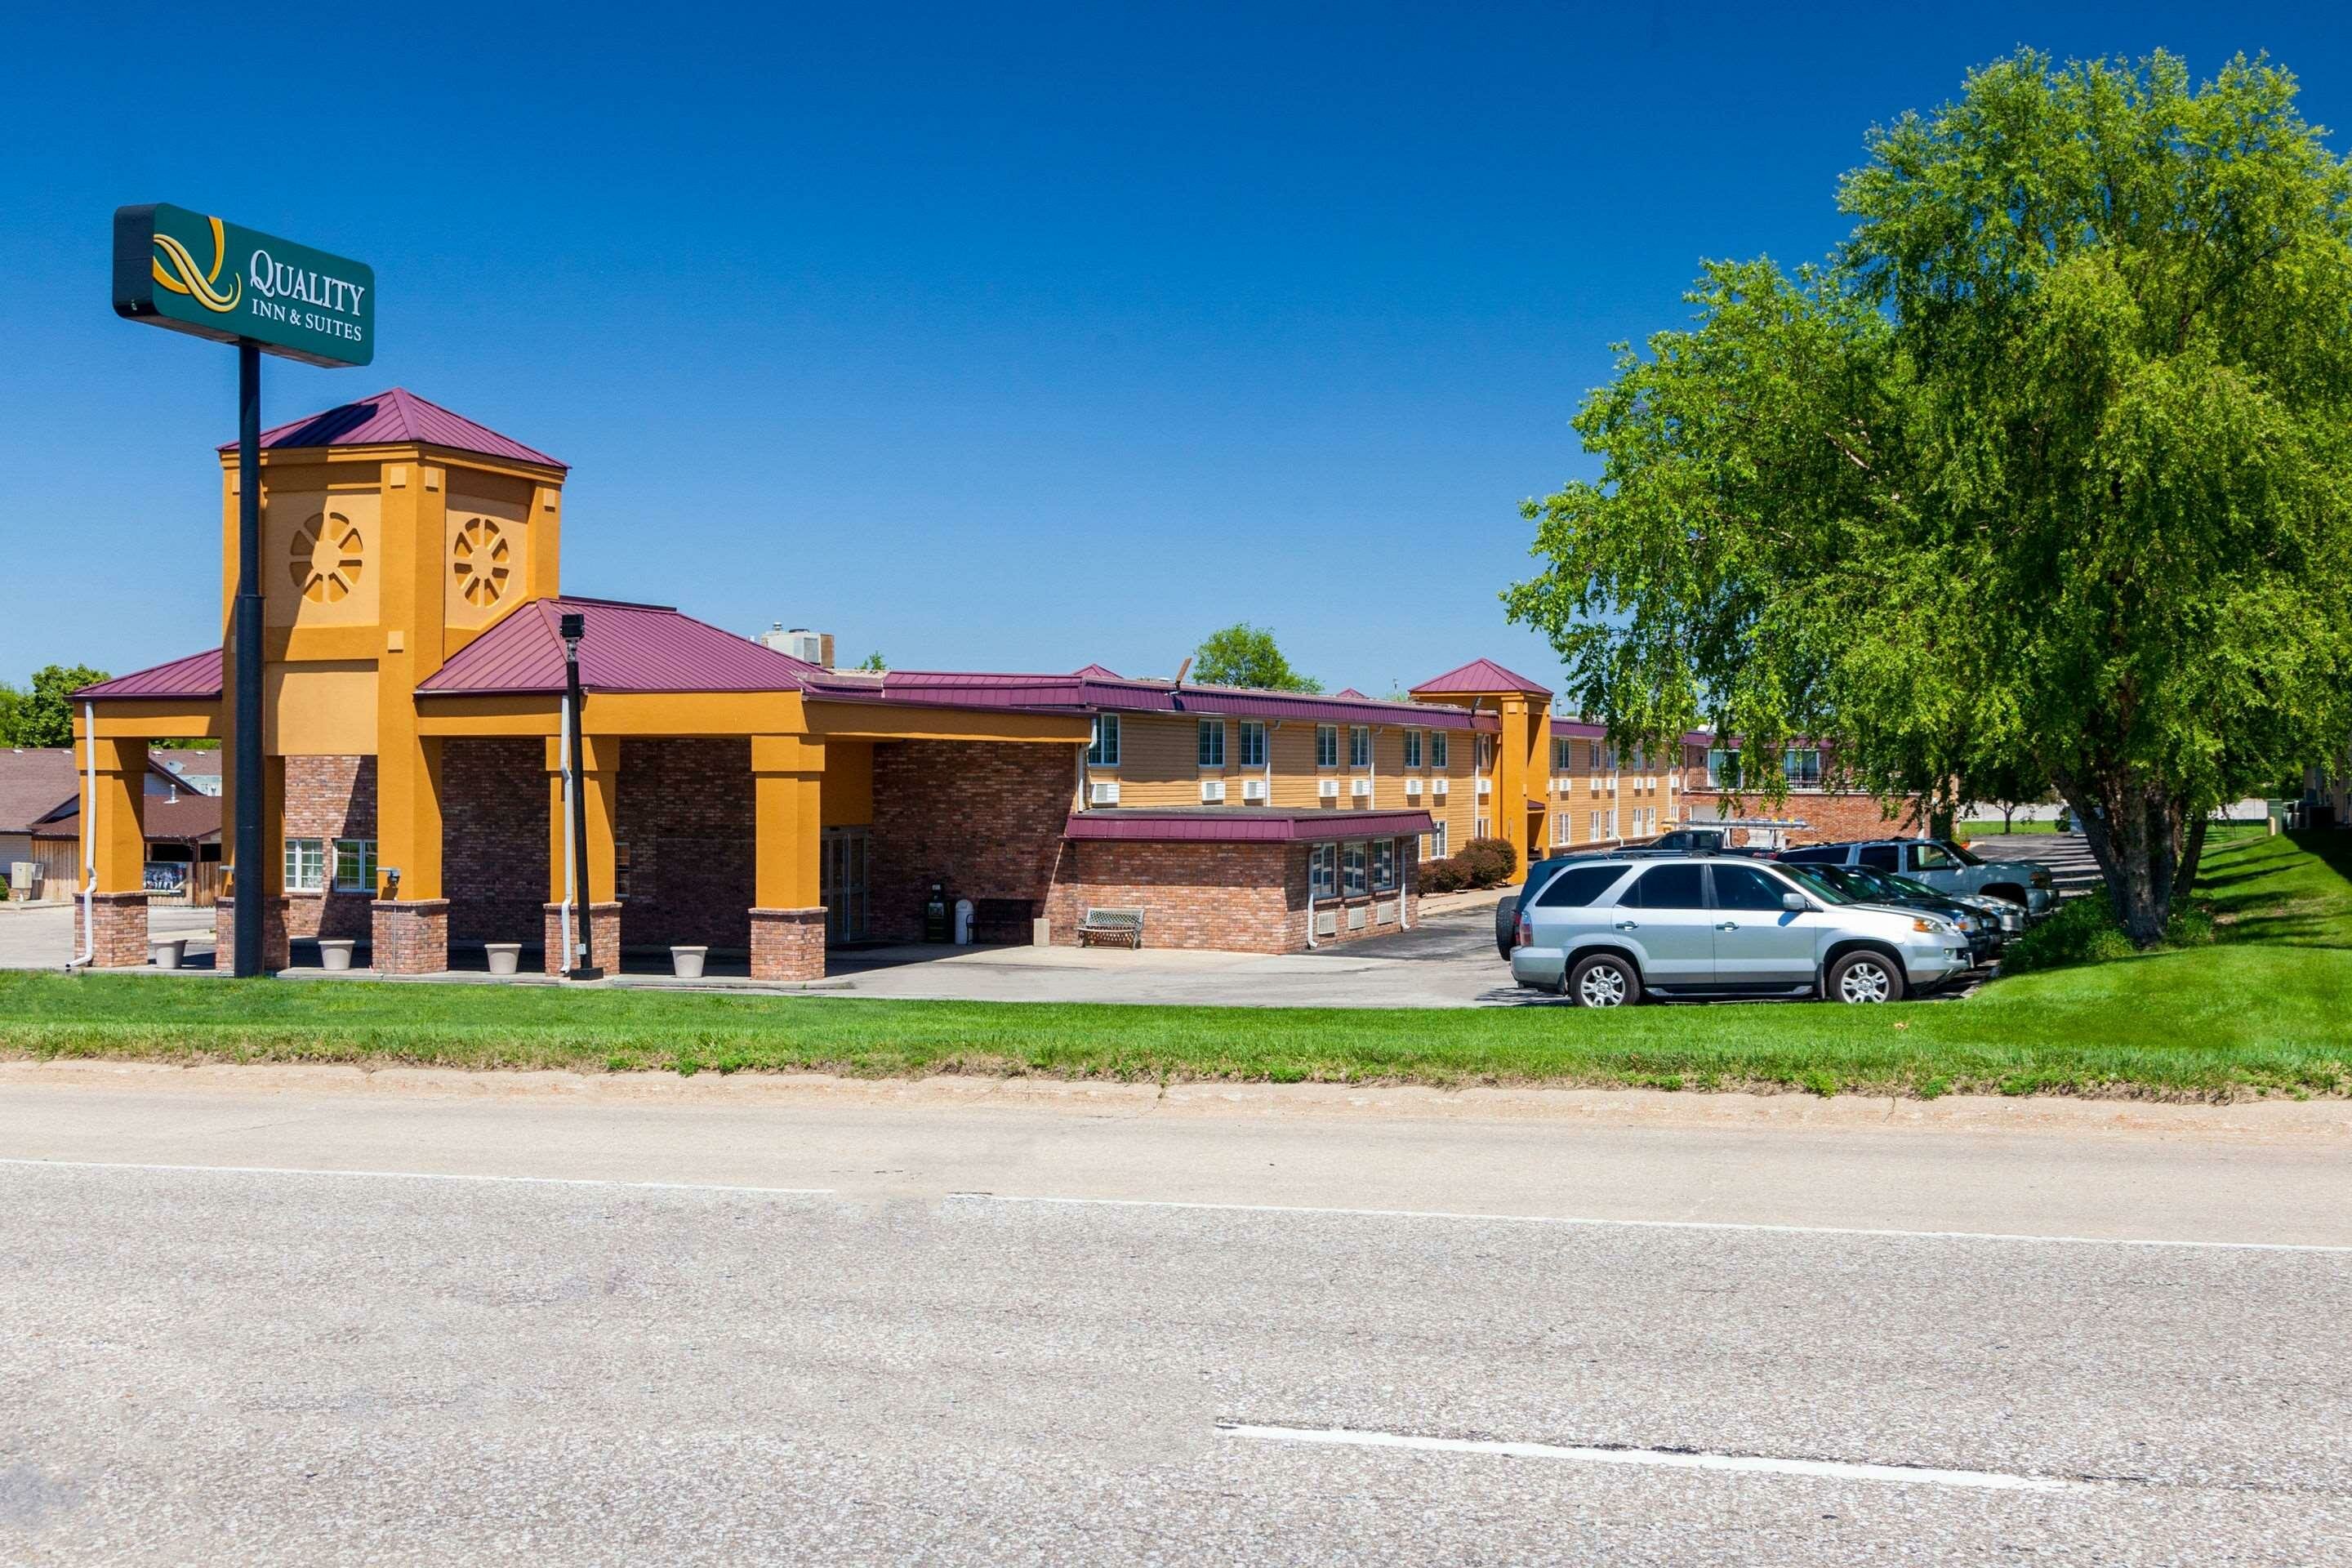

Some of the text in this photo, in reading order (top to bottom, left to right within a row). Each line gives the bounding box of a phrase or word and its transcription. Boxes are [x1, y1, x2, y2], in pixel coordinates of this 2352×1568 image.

[250, 250, 365, 316] QUALITY
[252, 298, 362, 341] INN & SUITES
